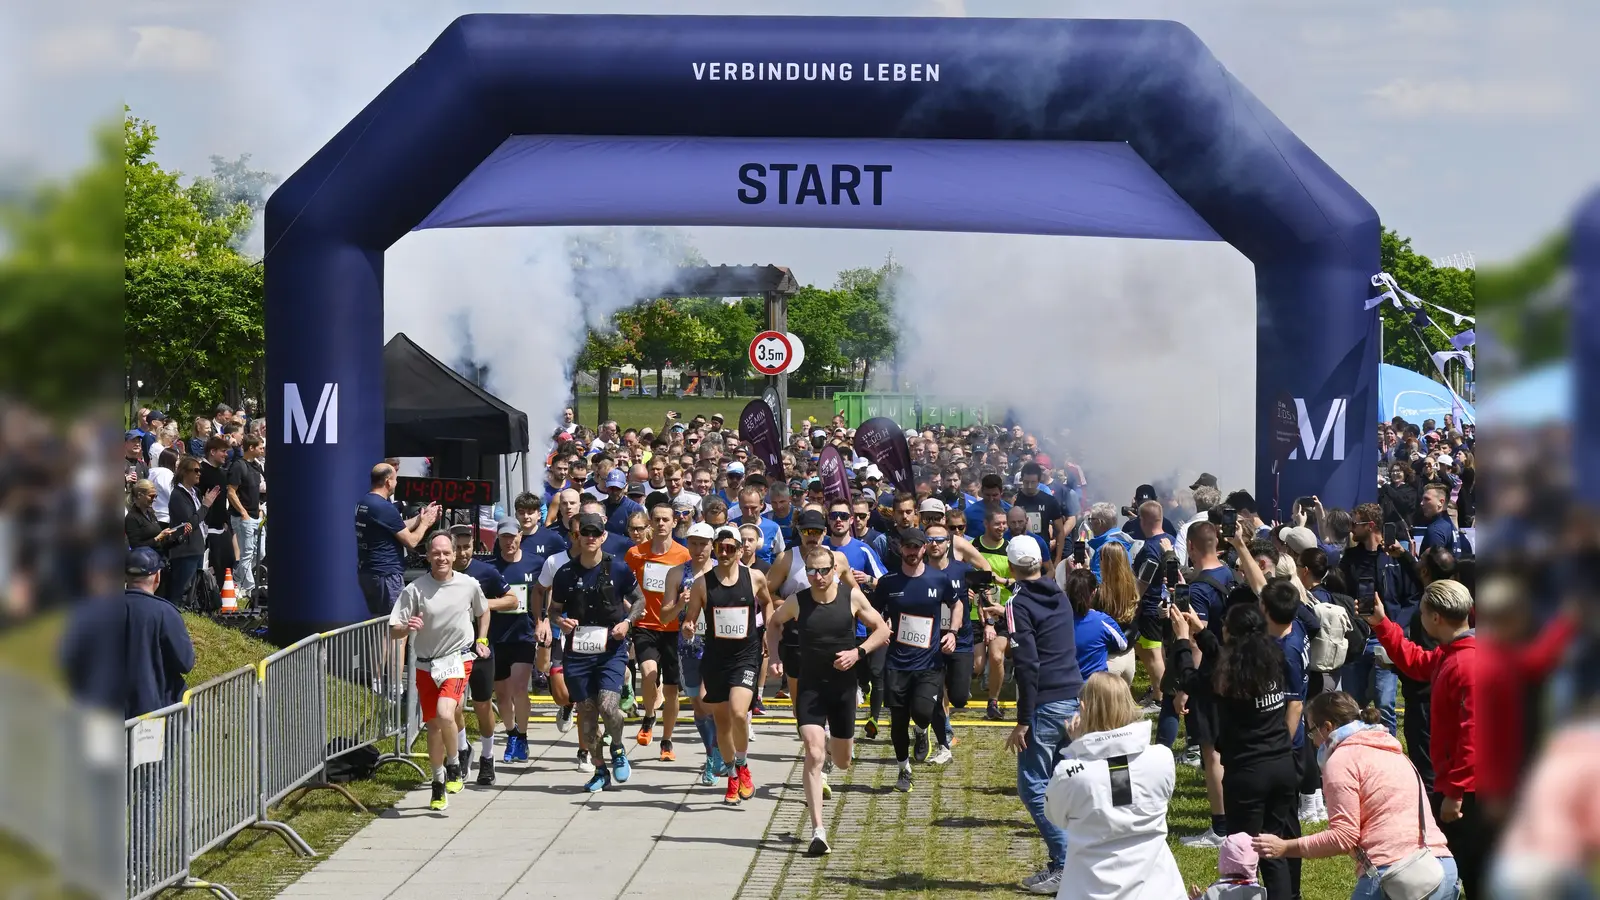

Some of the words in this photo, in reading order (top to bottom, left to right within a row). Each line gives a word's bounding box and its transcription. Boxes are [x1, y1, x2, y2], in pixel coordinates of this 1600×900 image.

[692, 62, 853, 81] VERBINDUNG
[863, 63, 940, 82] LEBEN
[737, 163, 892, 205] START
[283, 383, 338, 444] M
[894, 468, 907, 483] M
[405, 480, 492, 503] 14:00:27
[536, 545, 545, 553] M
[524, 573, 533, 582] M
[952, 579, 961, 589] M
[928, 588, 937, 598] M
[719, 624, 745, 635] 1046
[901, 630, 927, 644] 1069
[576, 641, 601, 652] 1034
[1255, 691, 1285, 709] Hilton
[1094, 733, 1112, 742] HELLY
[1111, 731, 1133, 740] HANSEN
[1066, 762, 1085, 778] HH
